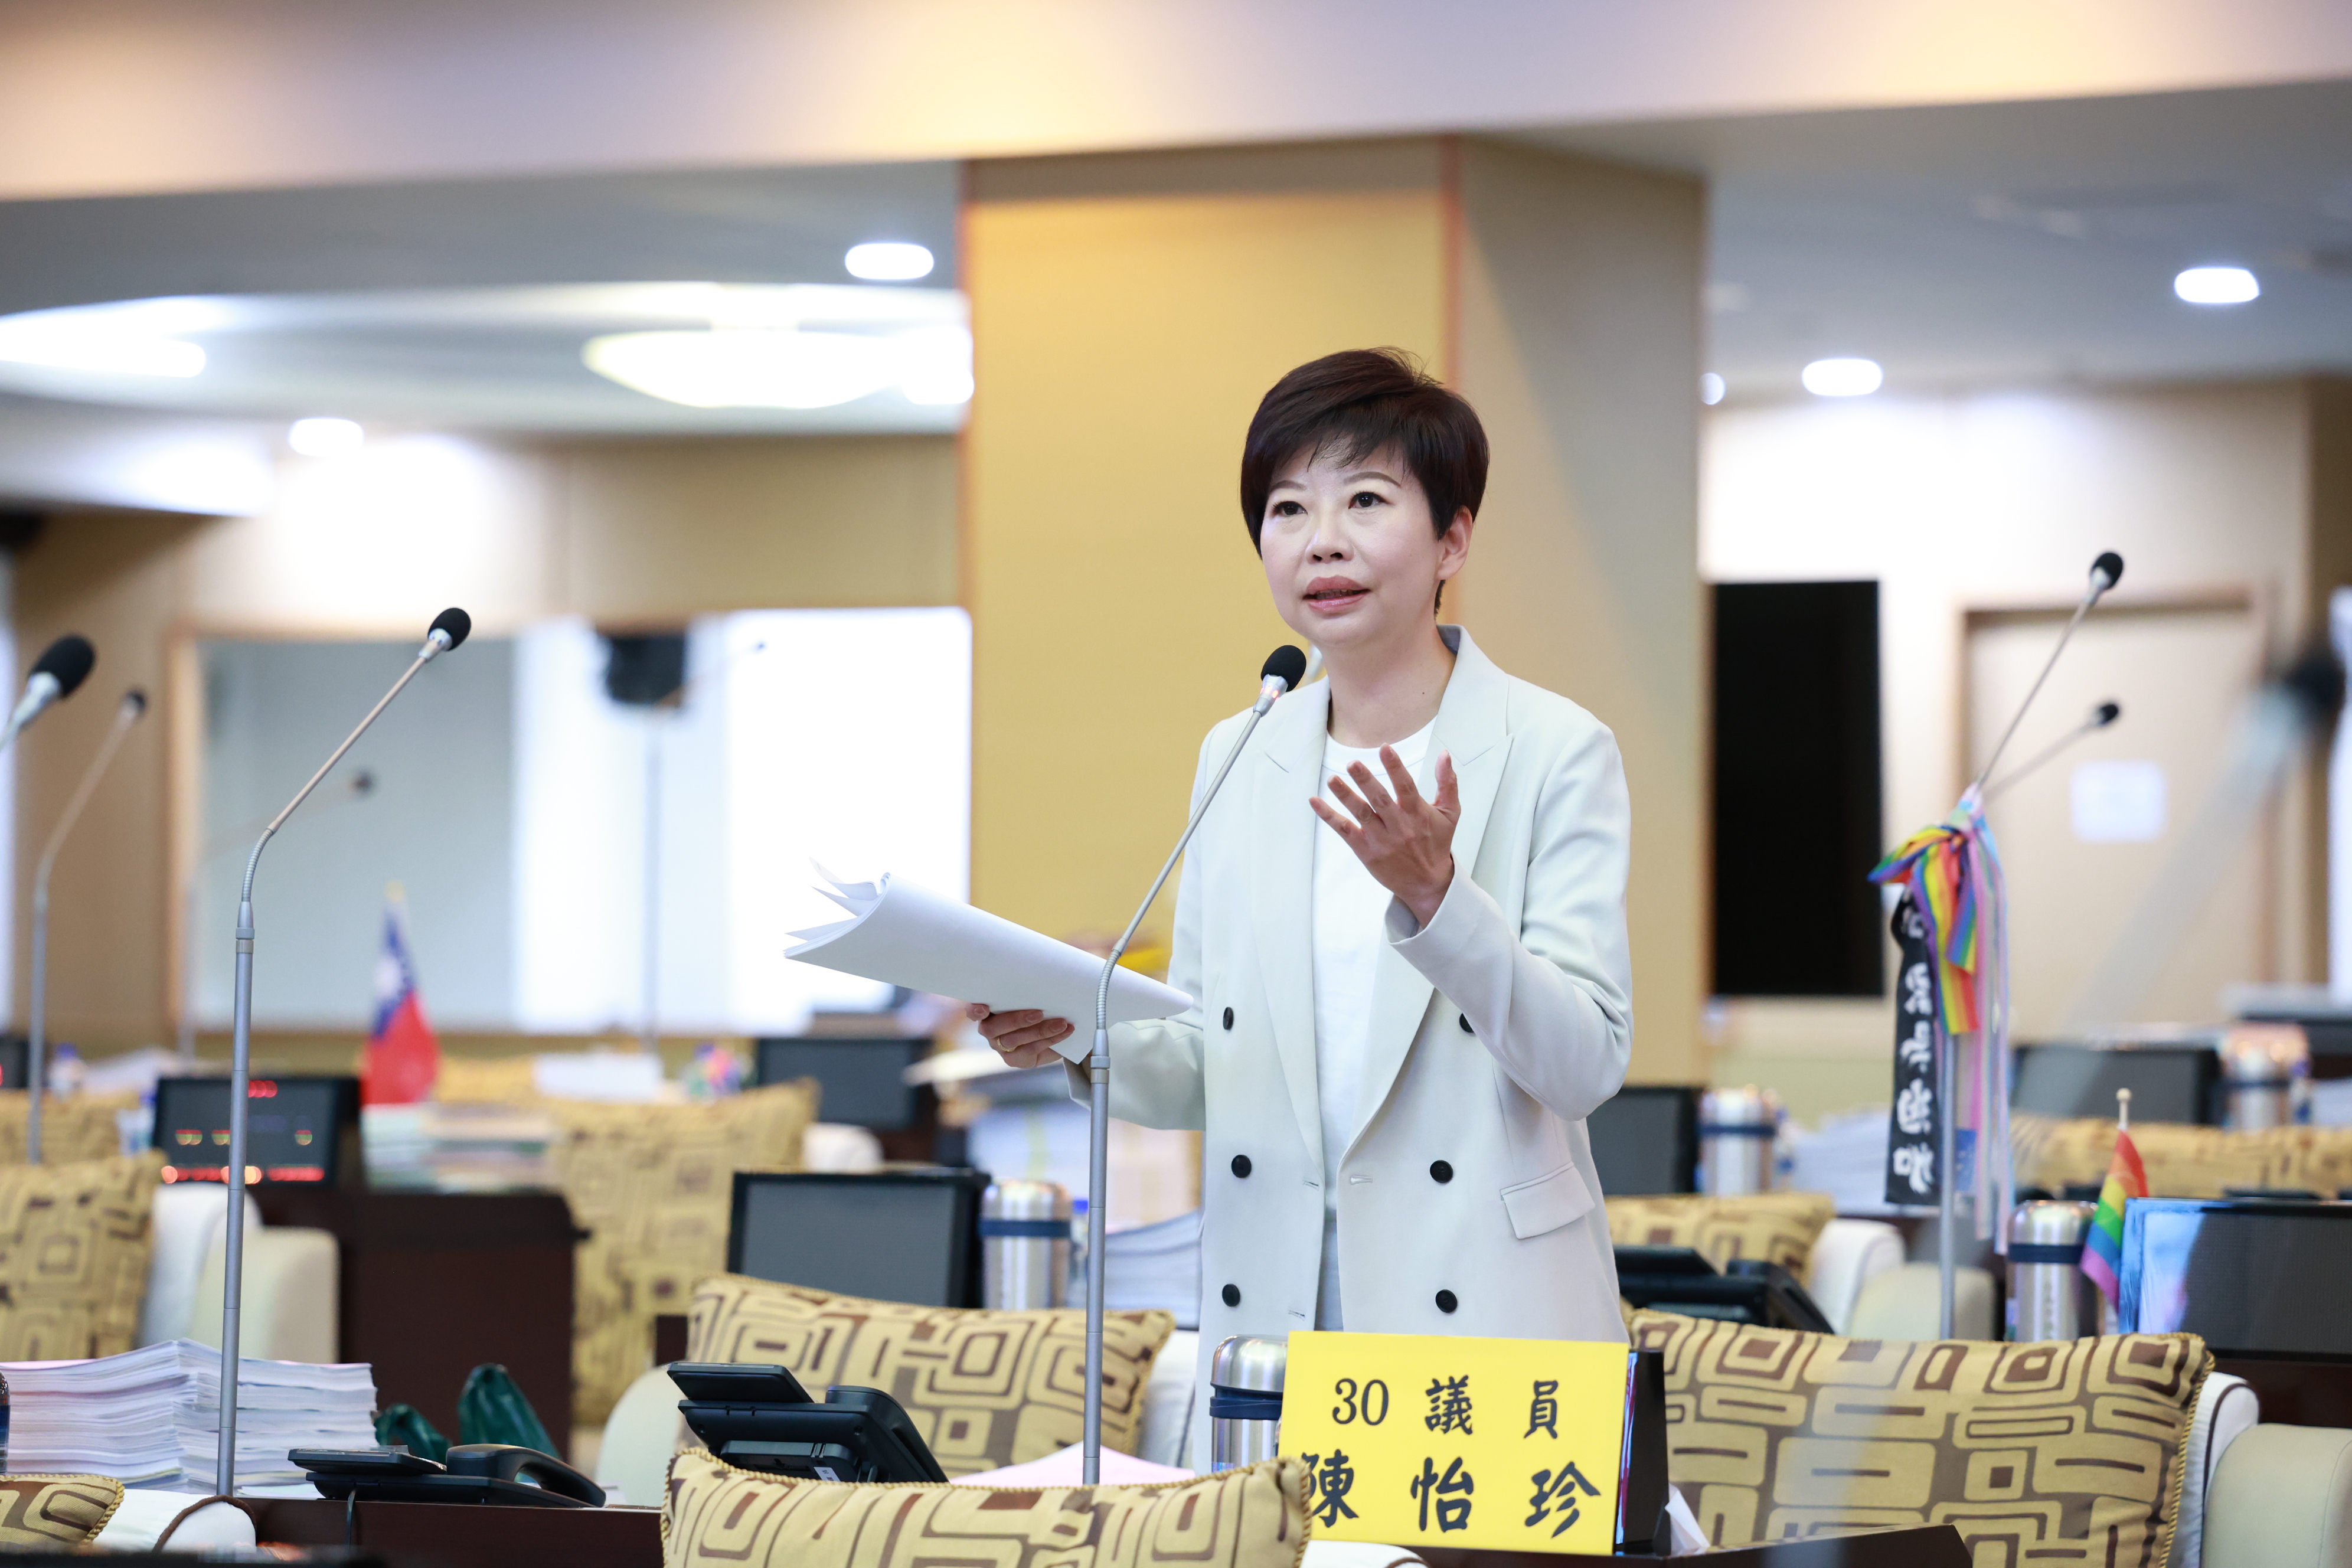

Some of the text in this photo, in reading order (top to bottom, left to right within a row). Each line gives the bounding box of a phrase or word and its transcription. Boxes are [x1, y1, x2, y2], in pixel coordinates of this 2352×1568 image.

[1333, 1378, 1389, 1425] 30
[1301, 1449, 1600, 1538] 陳怡珍
